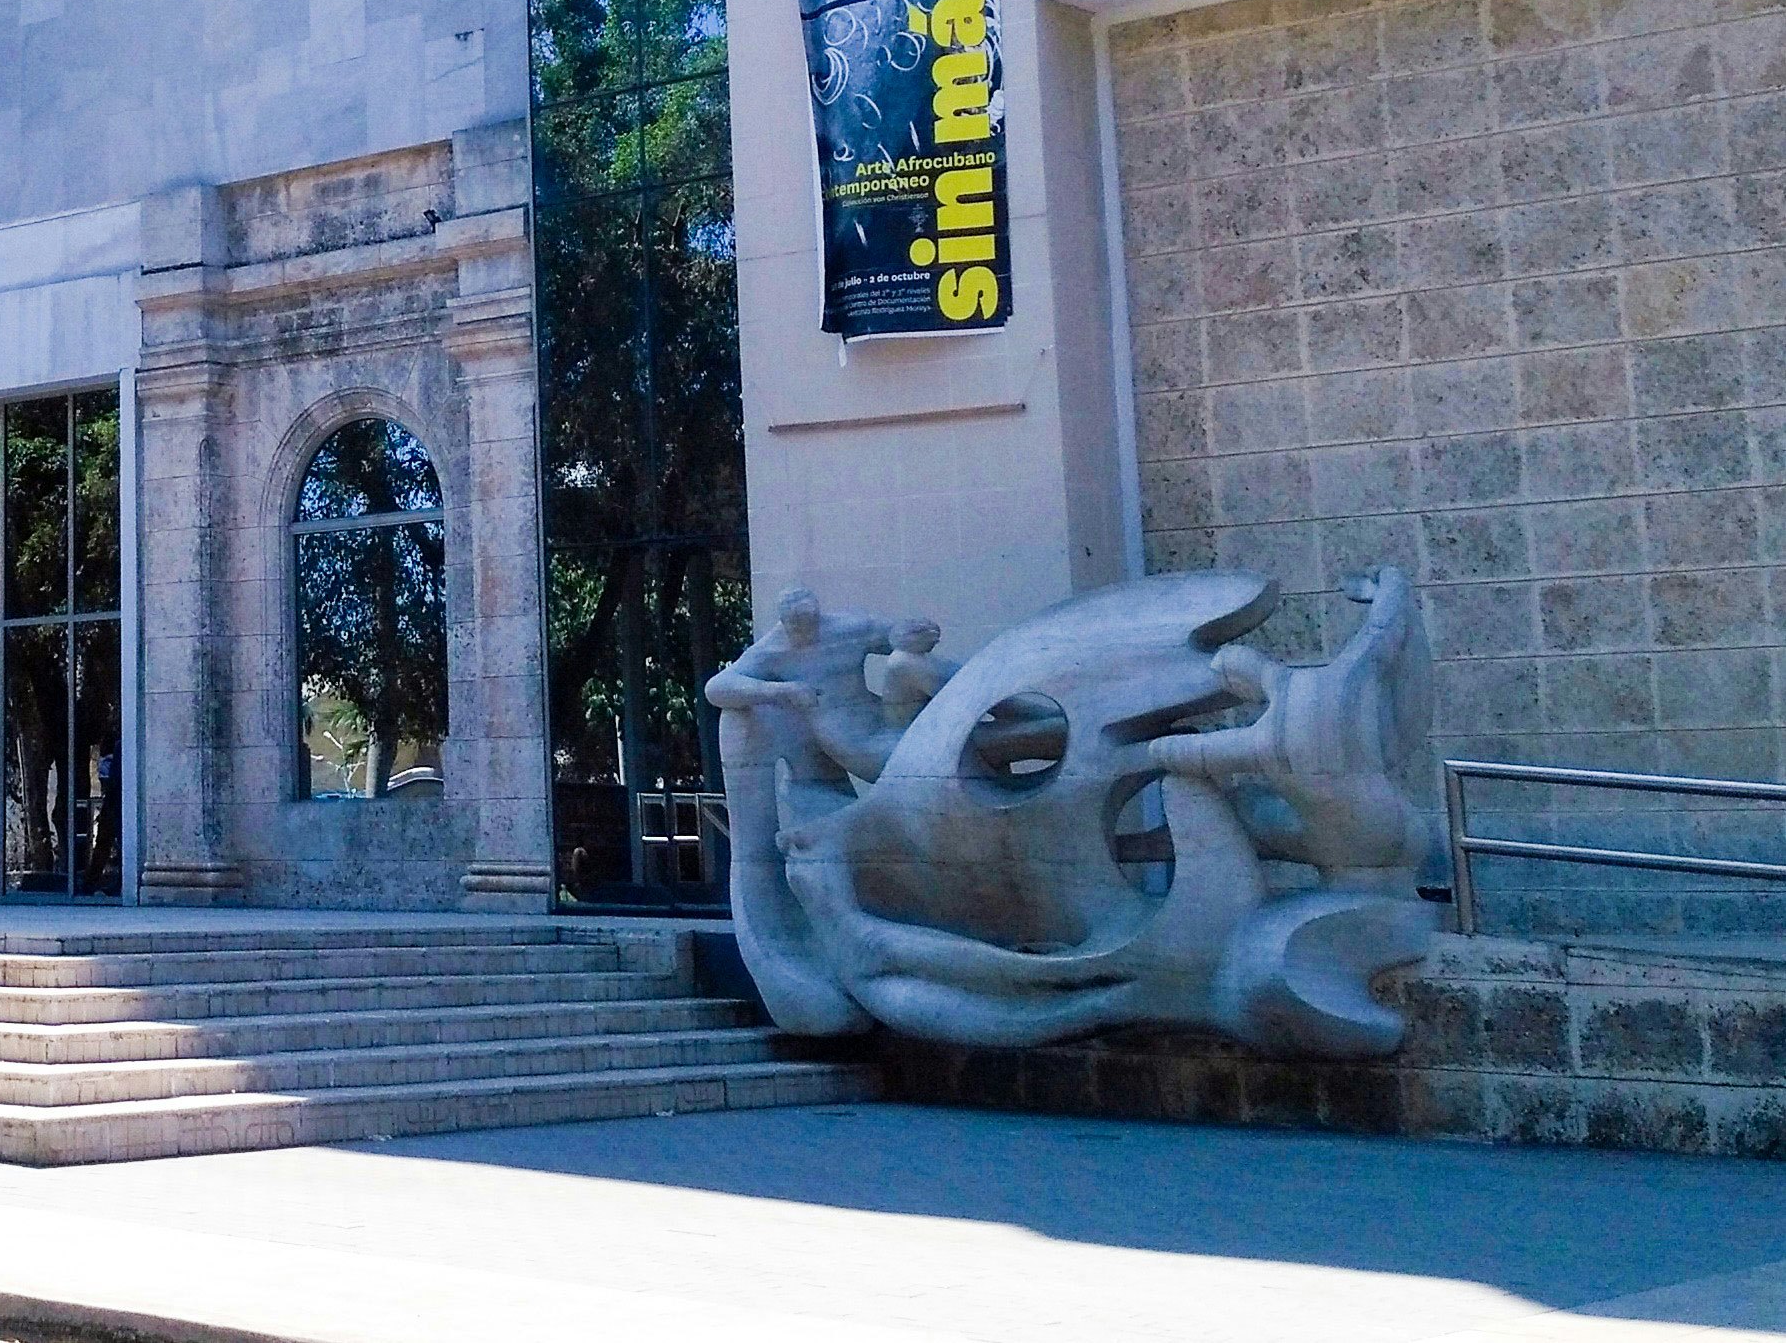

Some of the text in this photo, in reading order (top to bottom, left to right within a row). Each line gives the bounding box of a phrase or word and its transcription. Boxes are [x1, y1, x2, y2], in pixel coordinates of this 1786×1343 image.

[855, 151, 996, 177] Arte Afrocubano
[910, 166, 997, 321] sin
[844, 275, 862, 290] julio
[869, 275, 875, 284] 2
[877, 273, 889, 283] de
[891, 271, 931, 282] octubre
